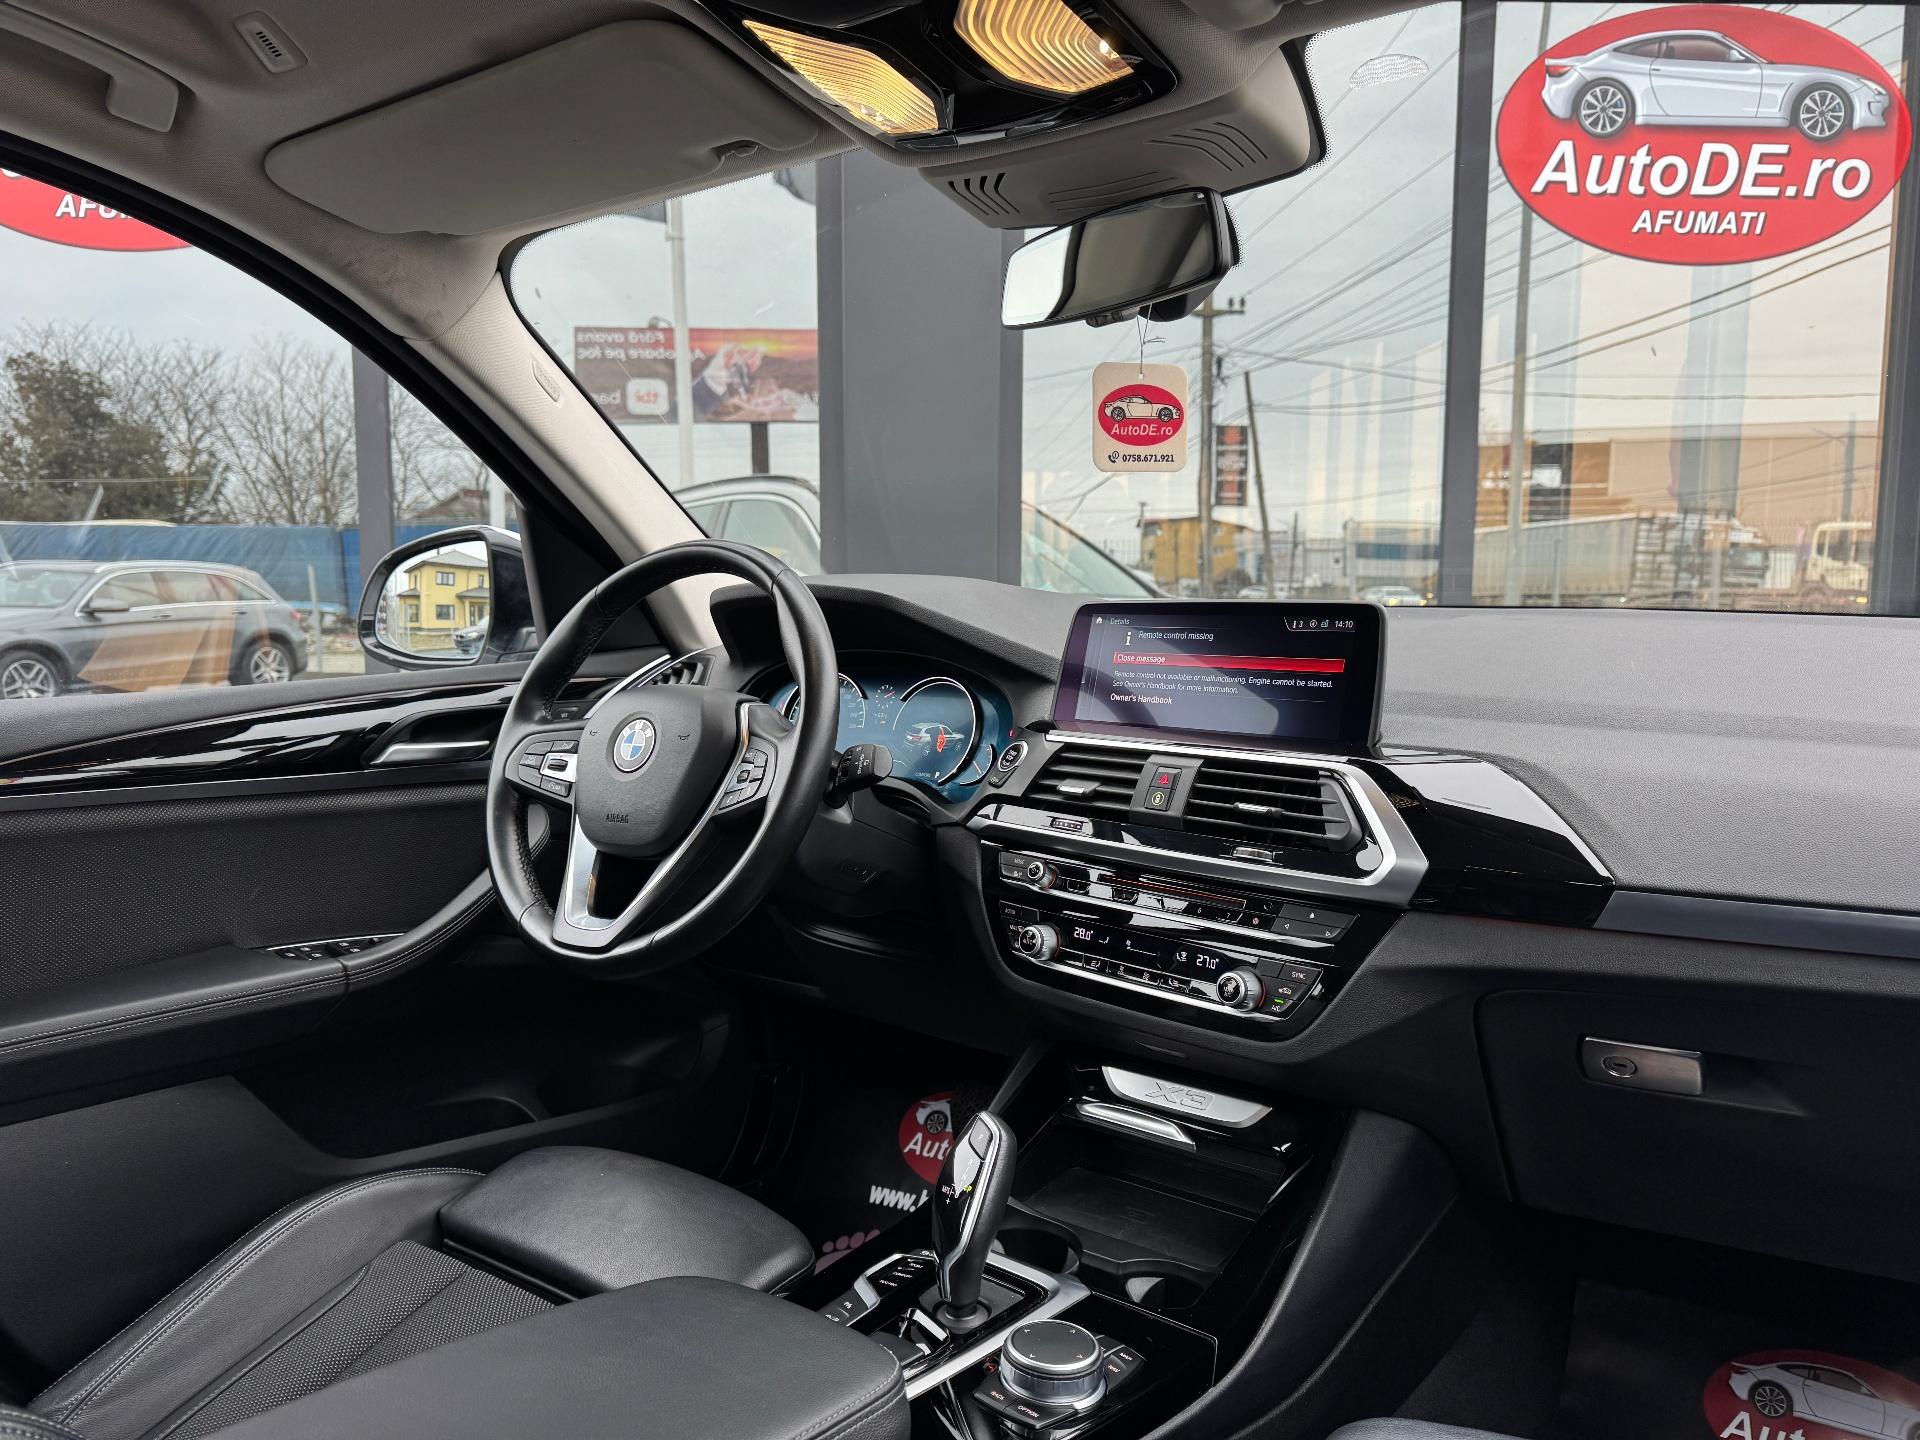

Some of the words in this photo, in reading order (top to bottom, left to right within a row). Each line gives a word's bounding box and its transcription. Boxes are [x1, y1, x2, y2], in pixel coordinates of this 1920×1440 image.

[1530, 139, 1873, 199] AutoDE.ro
[1631, 209, 1767, 235] AFUMATI
[1111, 423, 1173, 436] AutoDE.ro
[1122, 454, 1175, 463] 0758.671.921
[1334, 620, 1354, 628] 14:10
[1138, 630, 1162, 639] Remote
[1163, 631, 1187, 640] control
[1188, 632, 1214, 641] missing
[1117, 654, 1135, 662] Close
[1136, 655, 1166, 664] message
[1112, 679, 1122, 687] See
[1124, 680, 1146, 688] Owner's
[1146, 681, 1176, 690] Handbook
[1177, 682, 1185, 691] for
[1114, 670, 1135, 678] Remote
[1136, 671, 1156, 679] control
[1156, 672, 1167, 680] not
[1168, 672, 1192, 681] available
[1248, 676, 1271, 686] Engine
[1272, 677, 1295, 686] cannot
[1307, 680, 1333, 688] started.
[1110, 692, 1137, 702] Owner's
[1137, 694, 1173, 704] Handbook
[605, 812, 630, 824] AIRBAG
[1291, 971, 1306, 980] SYNC
[1145, 1080, 1216, 1111] X3
[903, 1131, 953, 1161] Aut
[1017, 1404, 1040, 1418] OPTION
